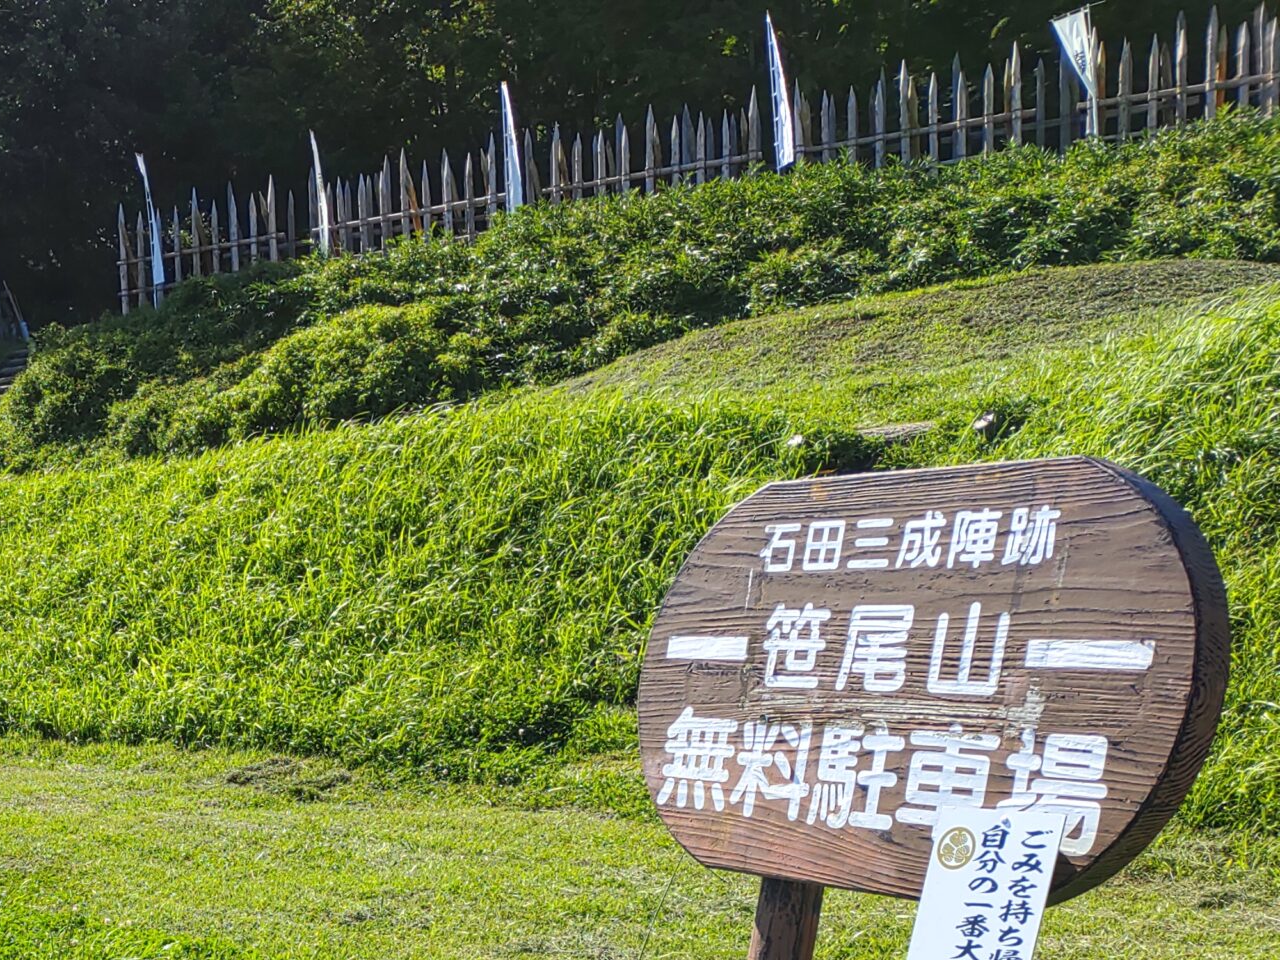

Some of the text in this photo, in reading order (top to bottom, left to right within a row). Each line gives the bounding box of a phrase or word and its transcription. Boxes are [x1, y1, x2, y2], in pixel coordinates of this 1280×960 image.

[759, 505, 1061, 572] 石田三成陣跡
[762, 602, 1011, 697] 笹尾山
[657, 707, 1108, 857] 無料駐車場
